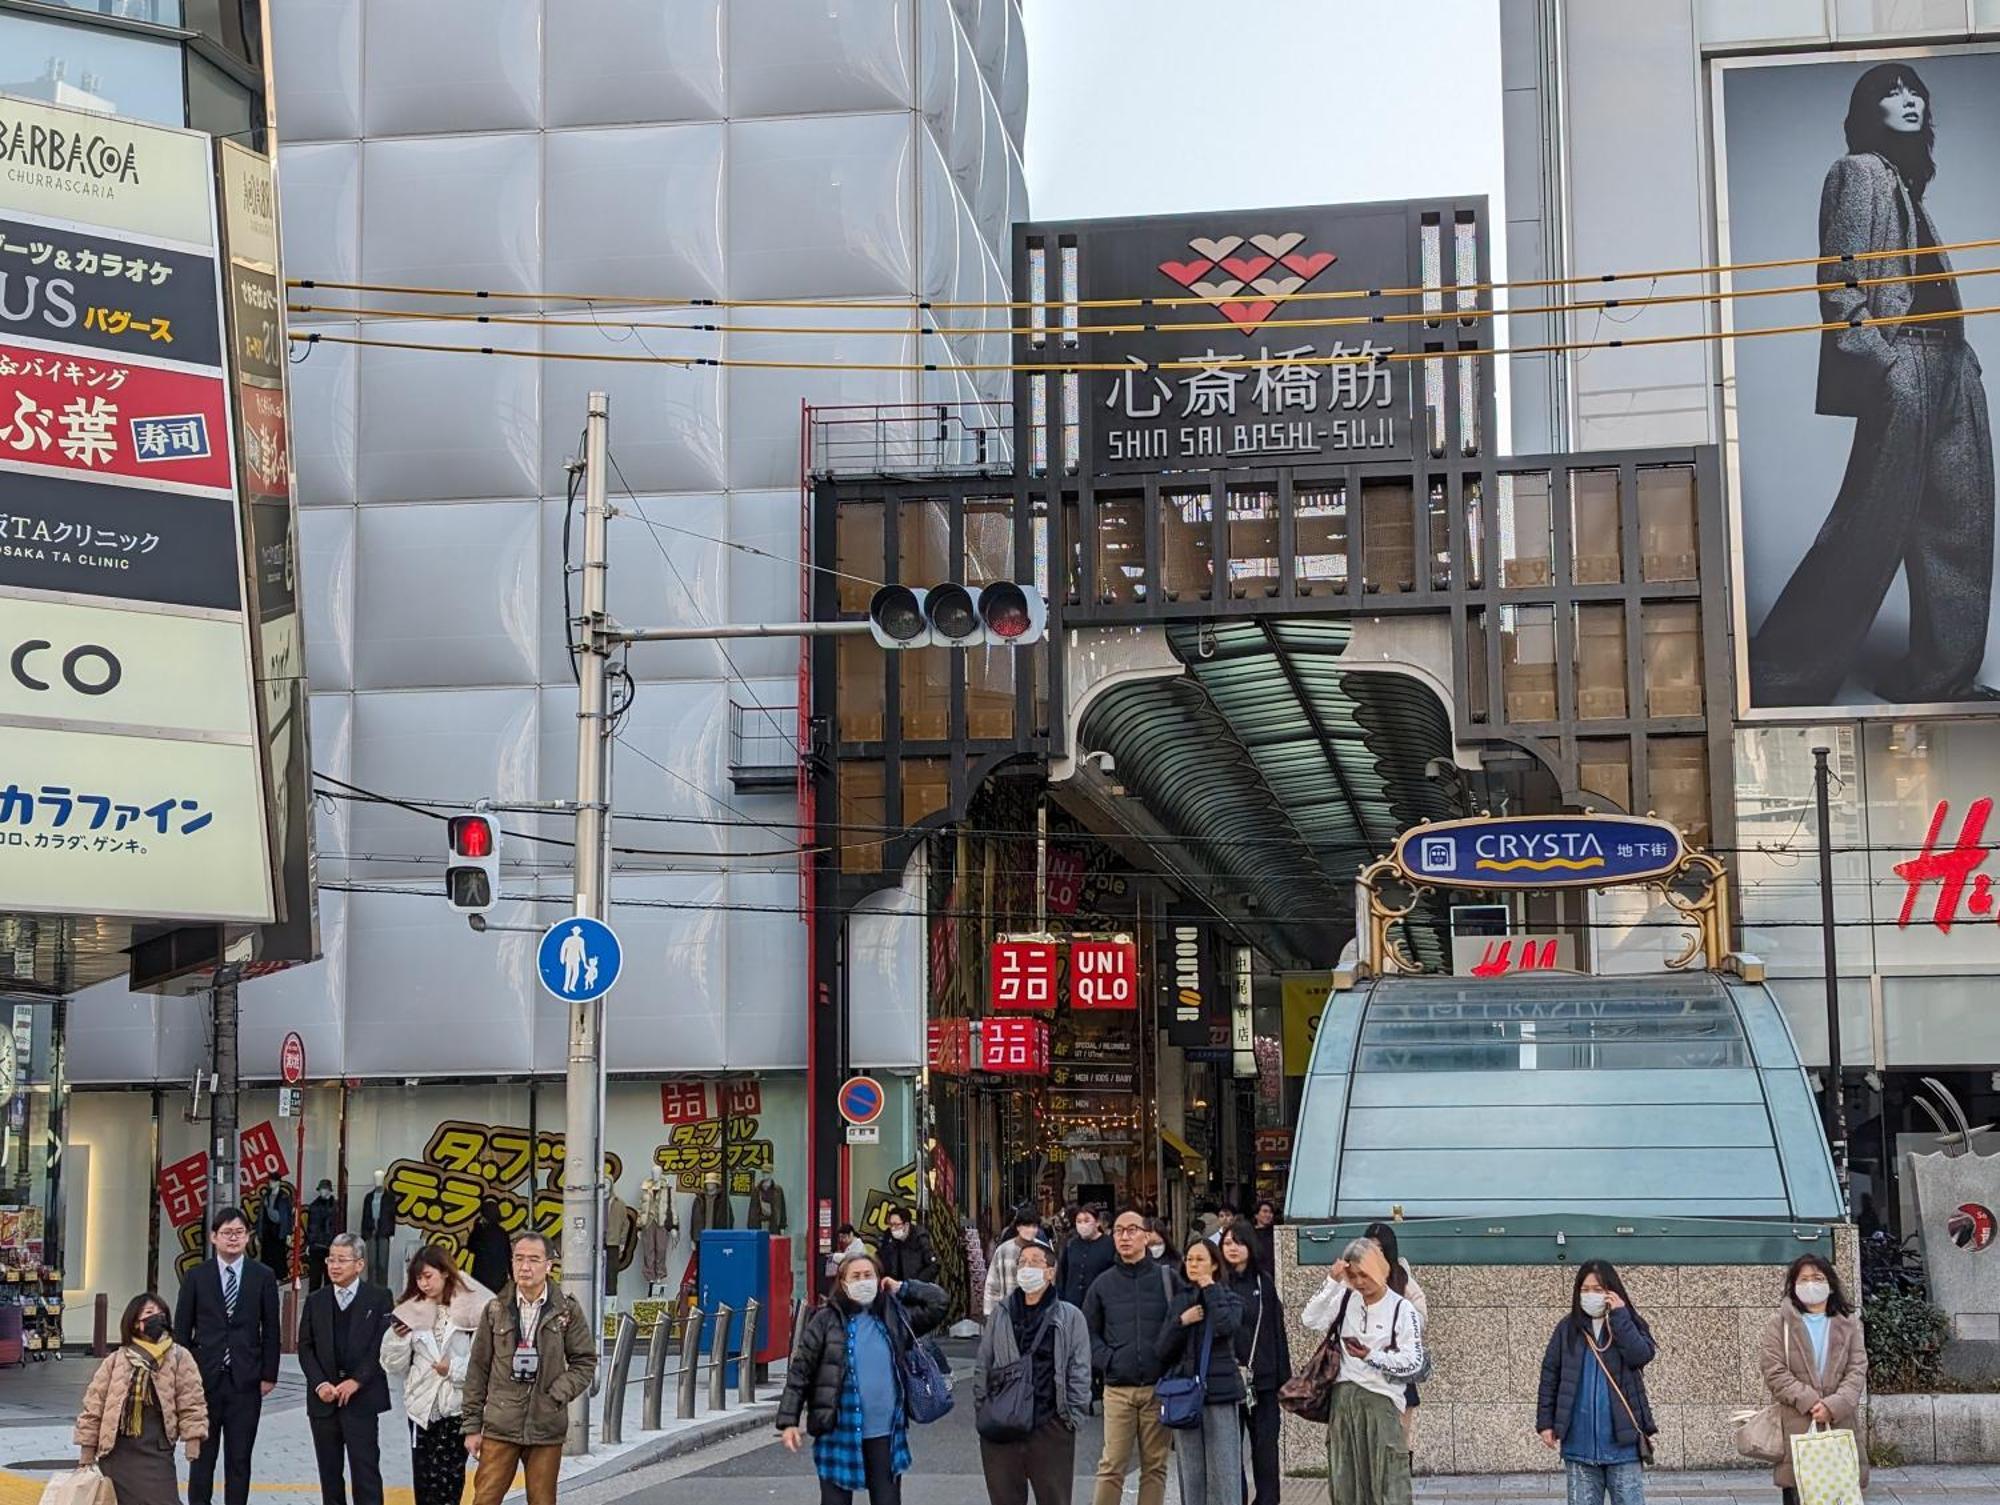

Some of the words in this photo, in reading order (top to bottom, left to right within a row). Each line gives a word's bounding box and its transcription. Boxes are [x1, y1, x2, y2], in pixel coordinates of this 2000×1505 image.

[8, 169, 115, 200] CHURRASCARIA
[0, 234, 173, 285] ーツ&カラオケ
[84, 307, 174, 344] バグース
[0, 354, 129, 390] ぶバイキング
[1106, 340, 1395, 419] 心斎橋筋
[0, 390, 118, 467] ぶ葉
[137, 420, 200, 456] 寿司
[1108, 422, 1168, 460] SHIN
[1180, 424, 1223, 456] SAI
[0, 545, 44, 560] SAKA
[52, 551, 71, 563] TA
[78, 554, 130, 569] CLINIC
[11, 639, 122, 695] CO
[0, 784, 213, 835] カラファイン
[1475, 833, 1605, 858] CRYSTA
[1616, 842, 1668, 858] 地下街
[1893, 797, 2000, 935] H&
[1001, 951, 1048, 973] ユニ
[1078, 951, 1124, 974] UNI
[1175, 926, 1202, 1021] DOUTOR
[999, 978, 1048, 1001] クロ
[1078, 978, 1128, 1003] QLO
[1235, 957, 1250, 1043] 中尾書店
[988, 1024, 1026, 1042] ユニ
[987, 1046, 1026, 1063] クロ
[433, 1131, 612, 1187] ダブ
[681, 1172, 752, 1193] @橋
[392, 1169, 564, 1239] デラック
[1410, 1311, 1419, 1339] HANG
